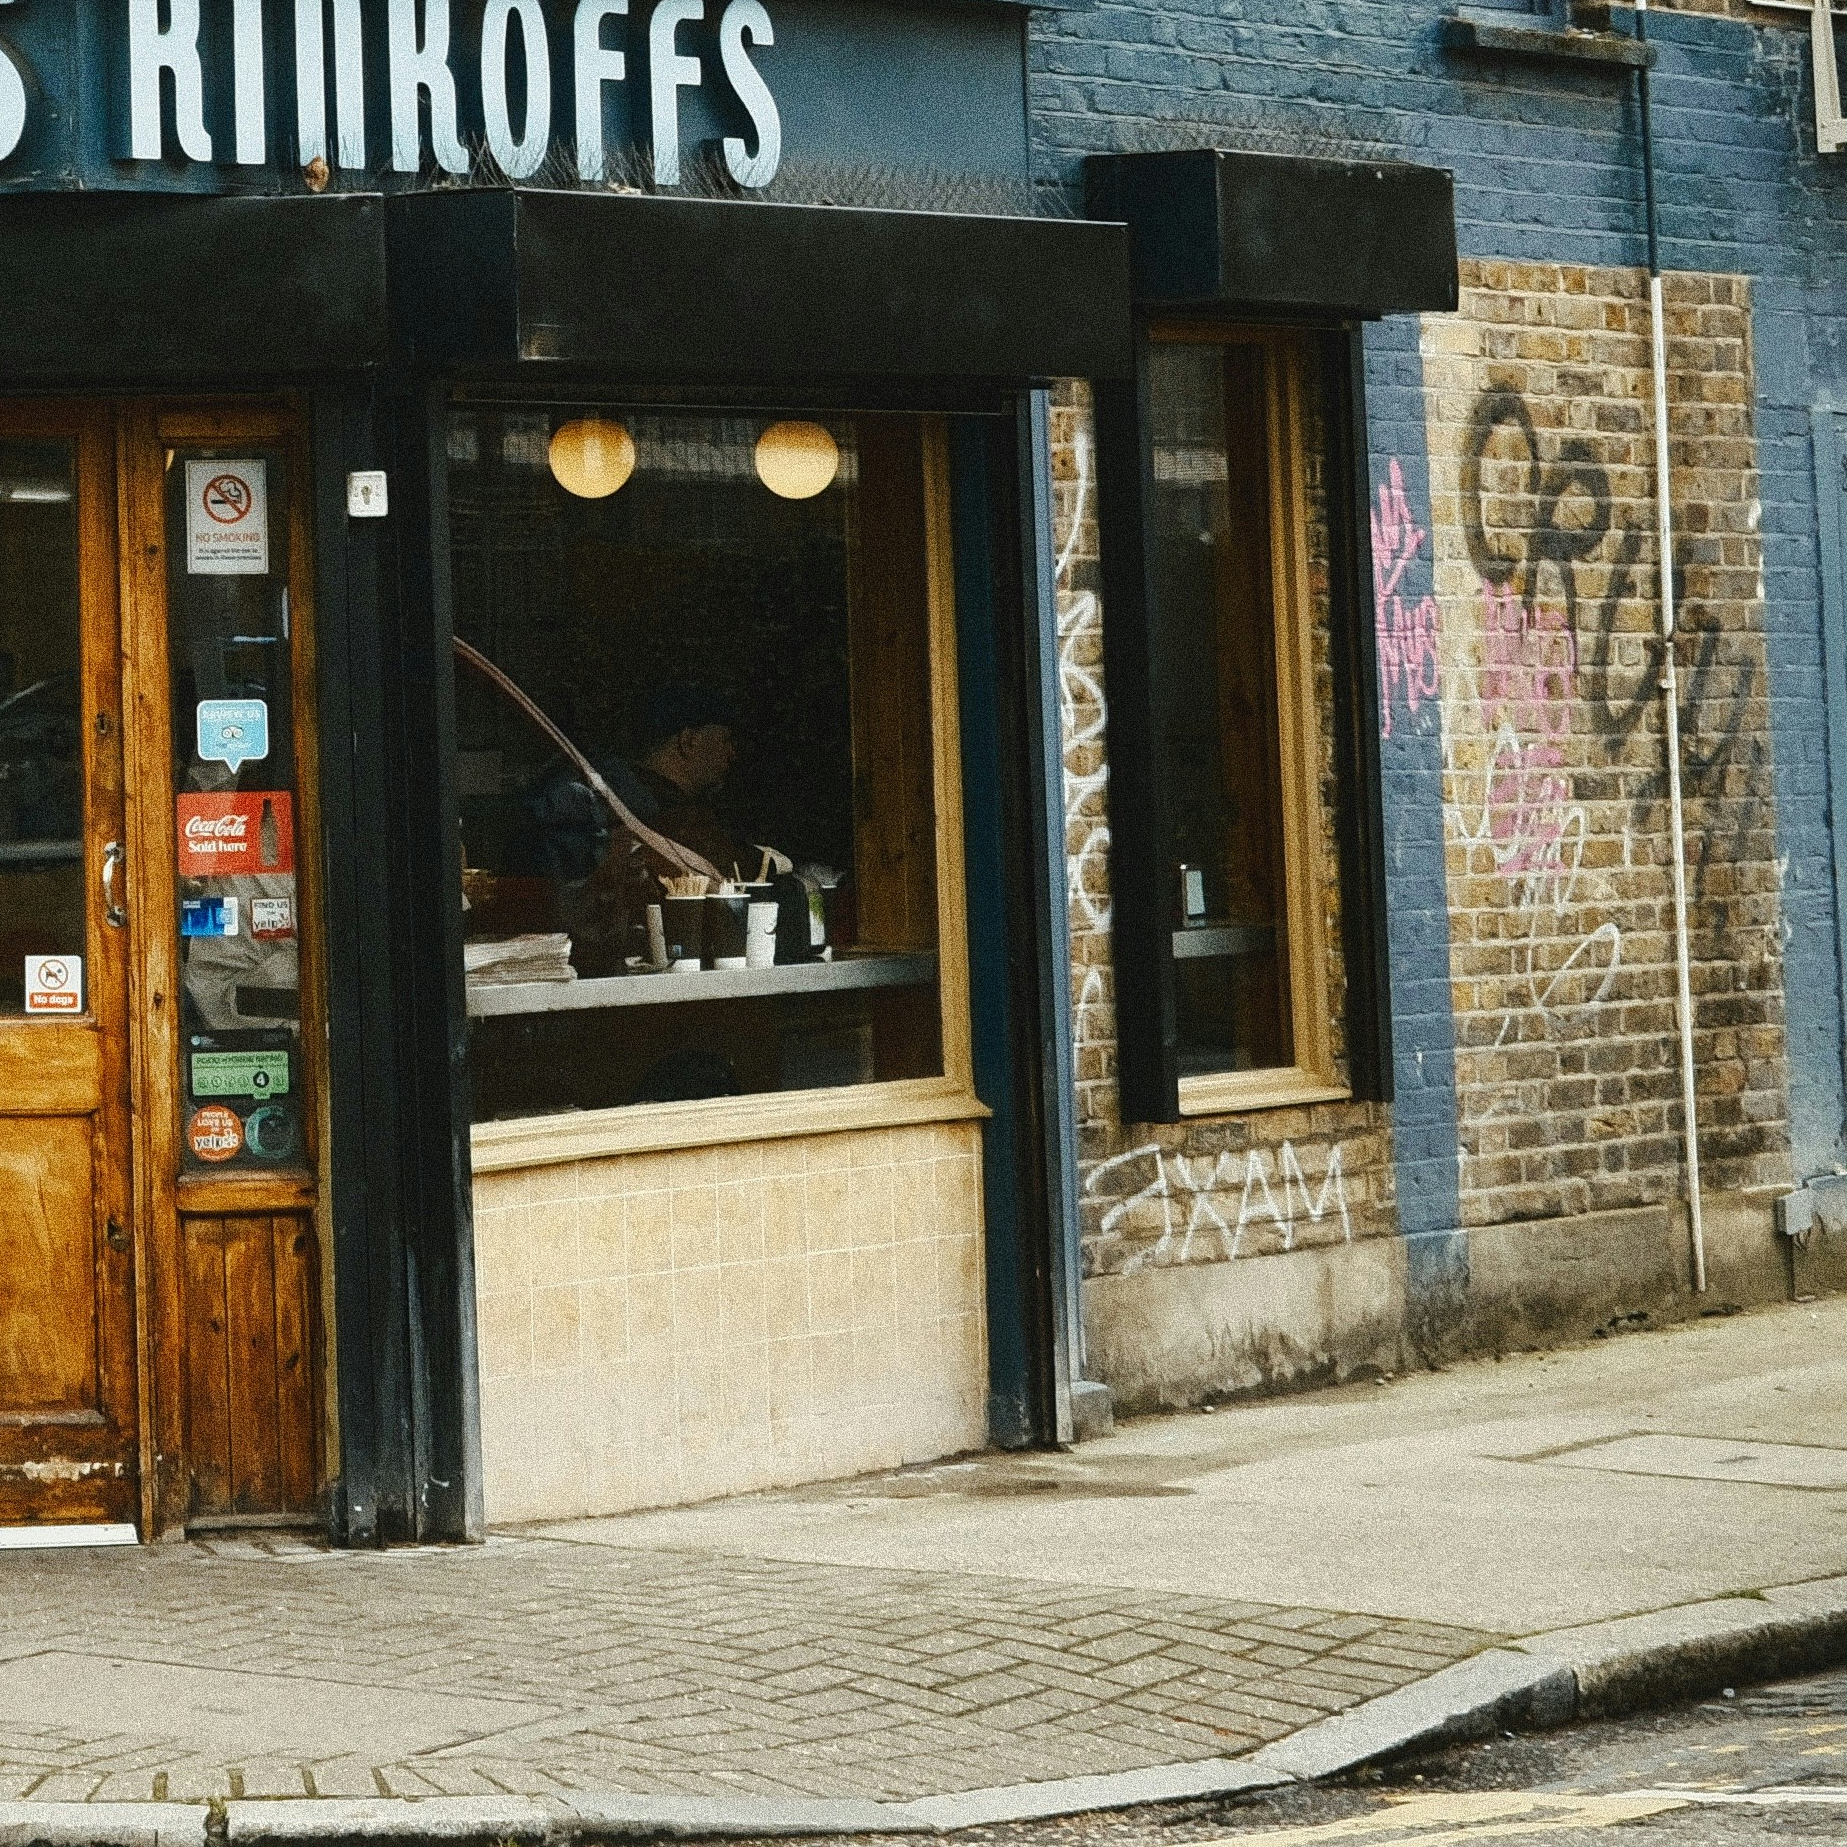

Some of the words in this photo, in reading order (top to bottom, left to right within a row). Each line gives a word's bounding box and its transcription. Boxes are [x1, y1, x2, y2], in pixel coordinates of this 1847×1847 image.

[195, 532, 210, 543] NO
[212, 532, 260, 543] SMOKING
[188, 839, 216, 853] Sold
[218, 840, 248, 853] here
[32, 993, 48, 1005] No
[49, 993, 74, 1007] dogs
